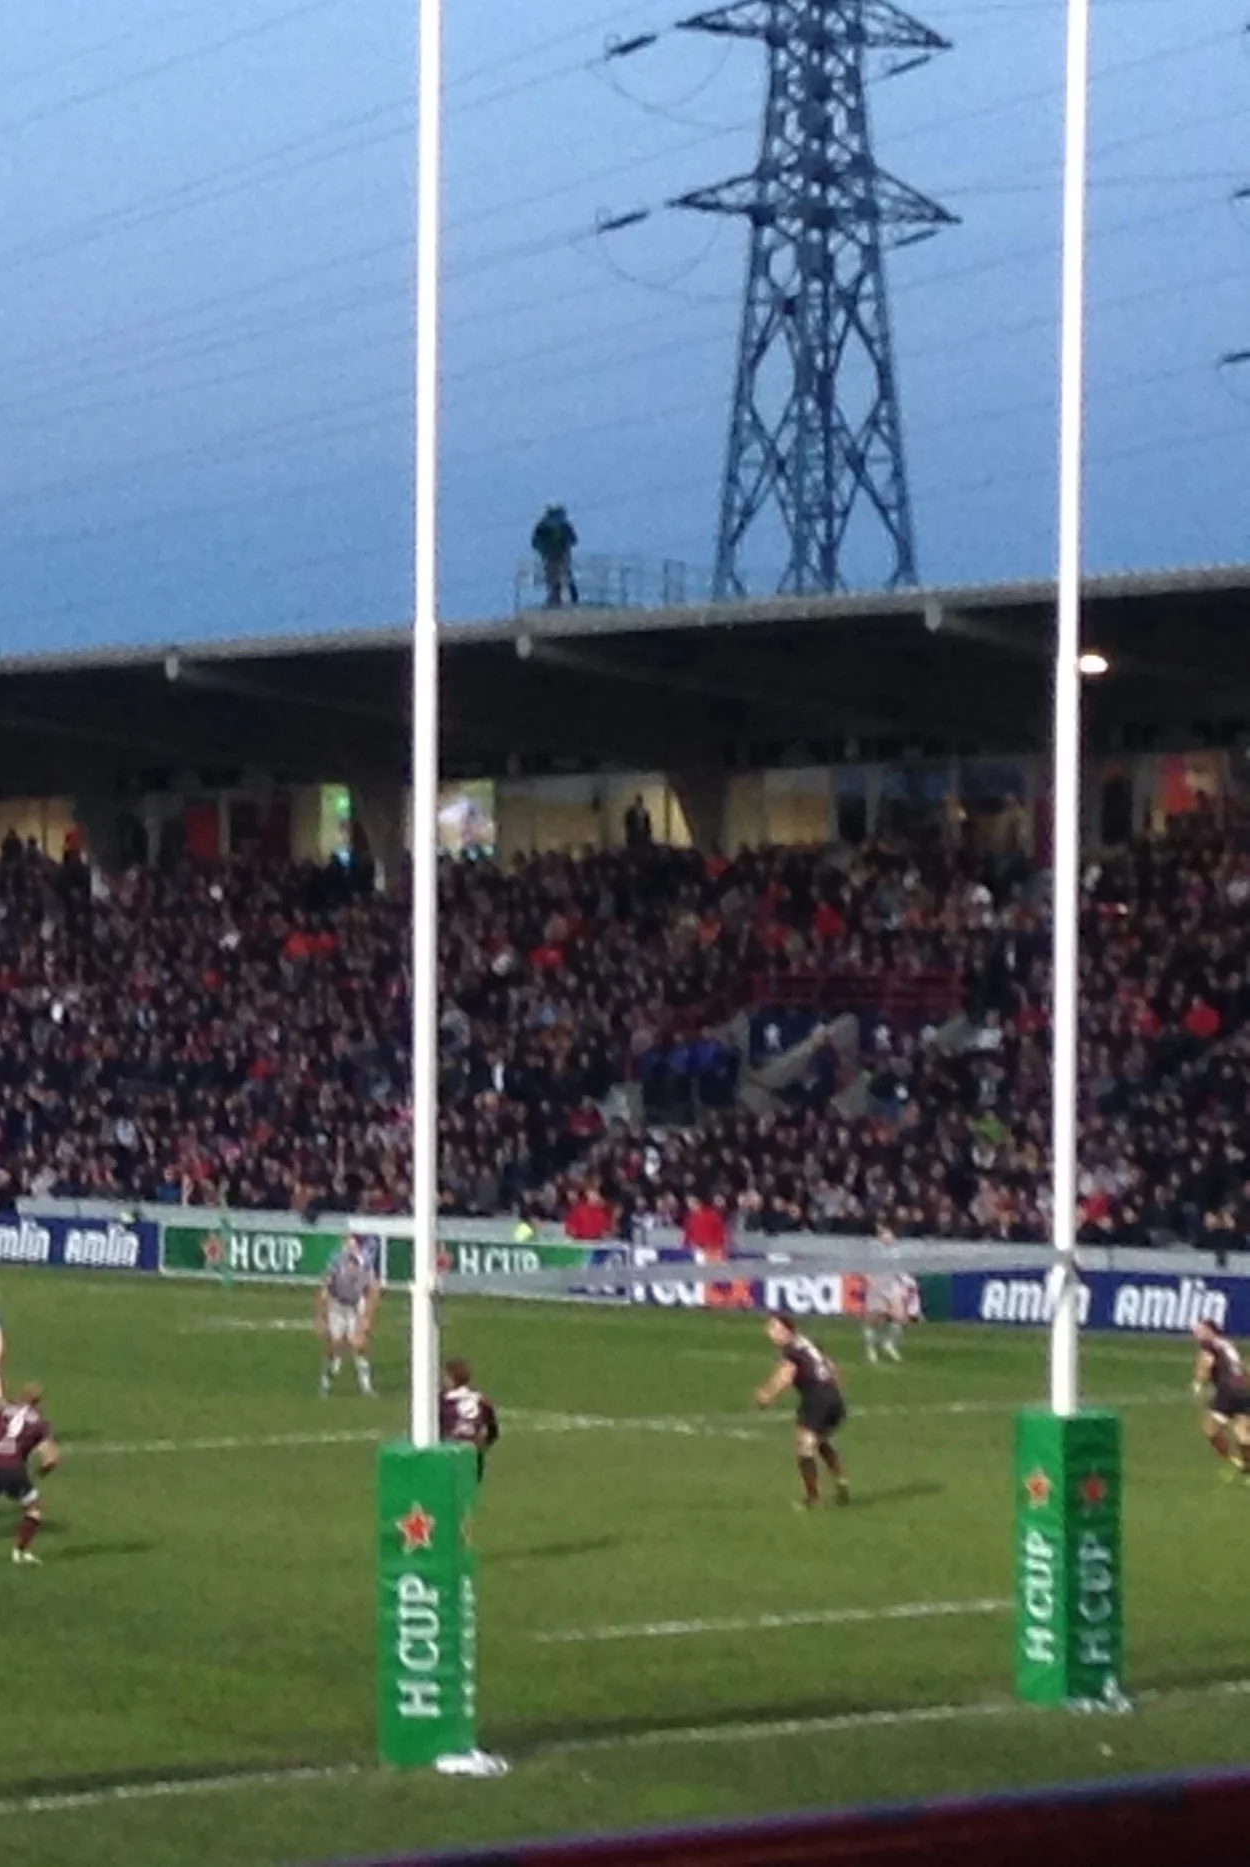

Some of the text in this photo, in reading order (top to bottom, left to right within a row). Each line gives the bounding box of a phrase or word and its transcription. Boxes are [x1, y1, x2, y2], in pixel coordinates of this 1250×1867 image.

[230, 1233, 303, 1273] H CUP
[458, 1243, 479, 1277] H
[397, 1571, 441, 1719] H CUP
[1023, 1528, 1055, 1665] H CUP
[1077, 1532, 1113, 1664] H CUP
